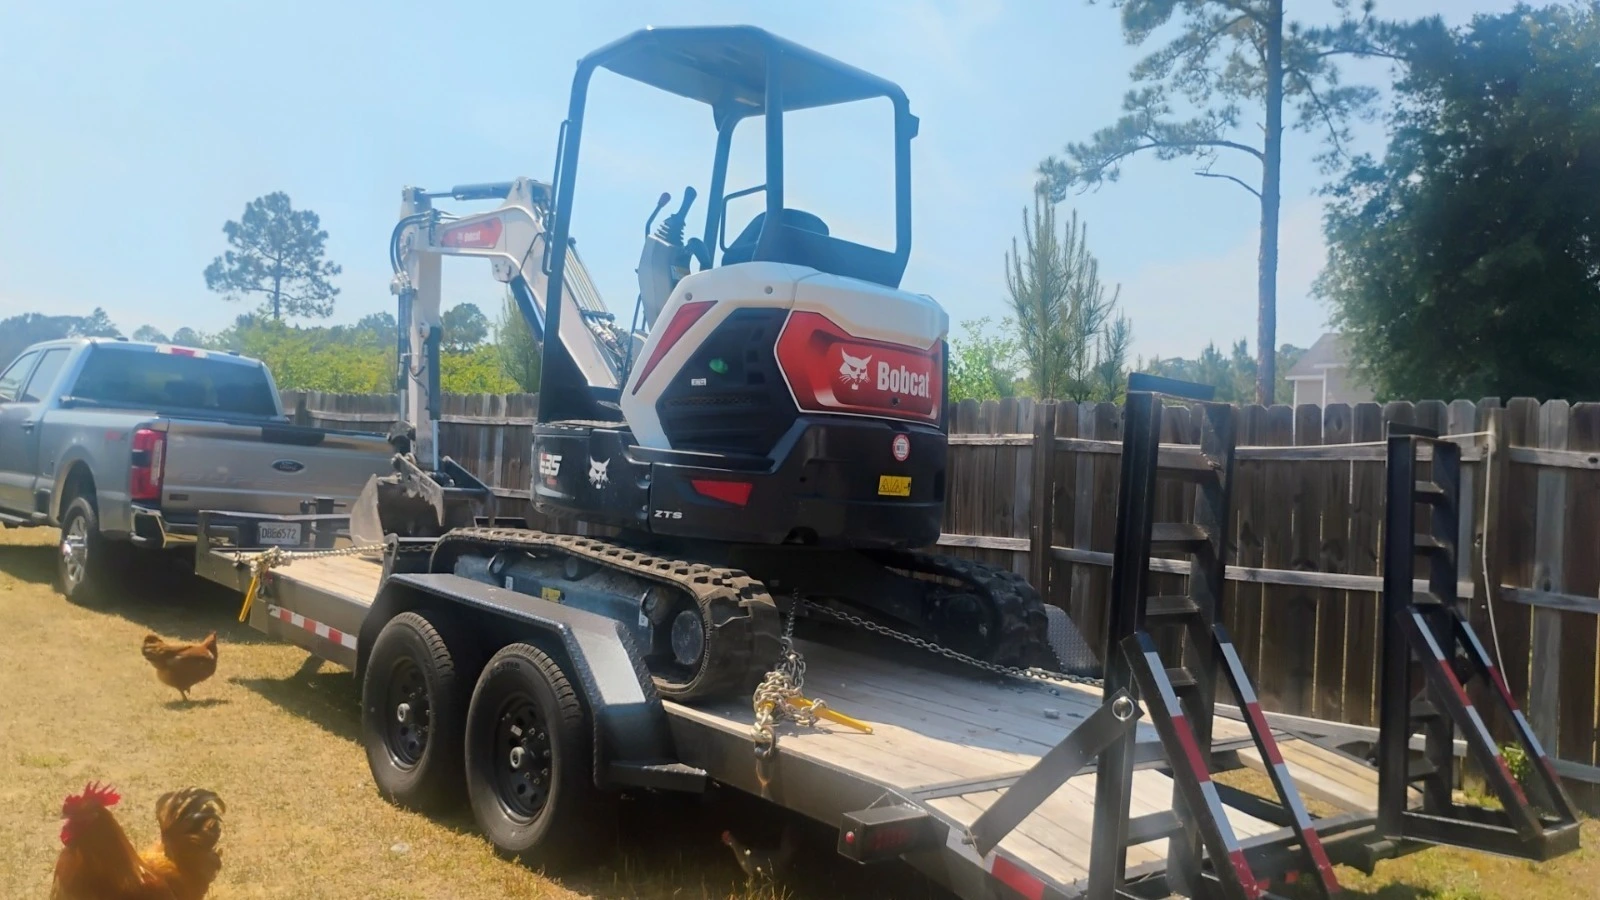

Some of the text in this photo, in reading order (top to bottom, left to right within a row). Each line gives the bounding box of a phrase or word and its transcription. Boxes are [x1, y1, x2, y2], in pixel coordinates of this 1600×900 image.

[877, 361, 929, 399] Bobcat
[540, 453, 562, 476] E35
[654, 509, 683, 519] ZTS
